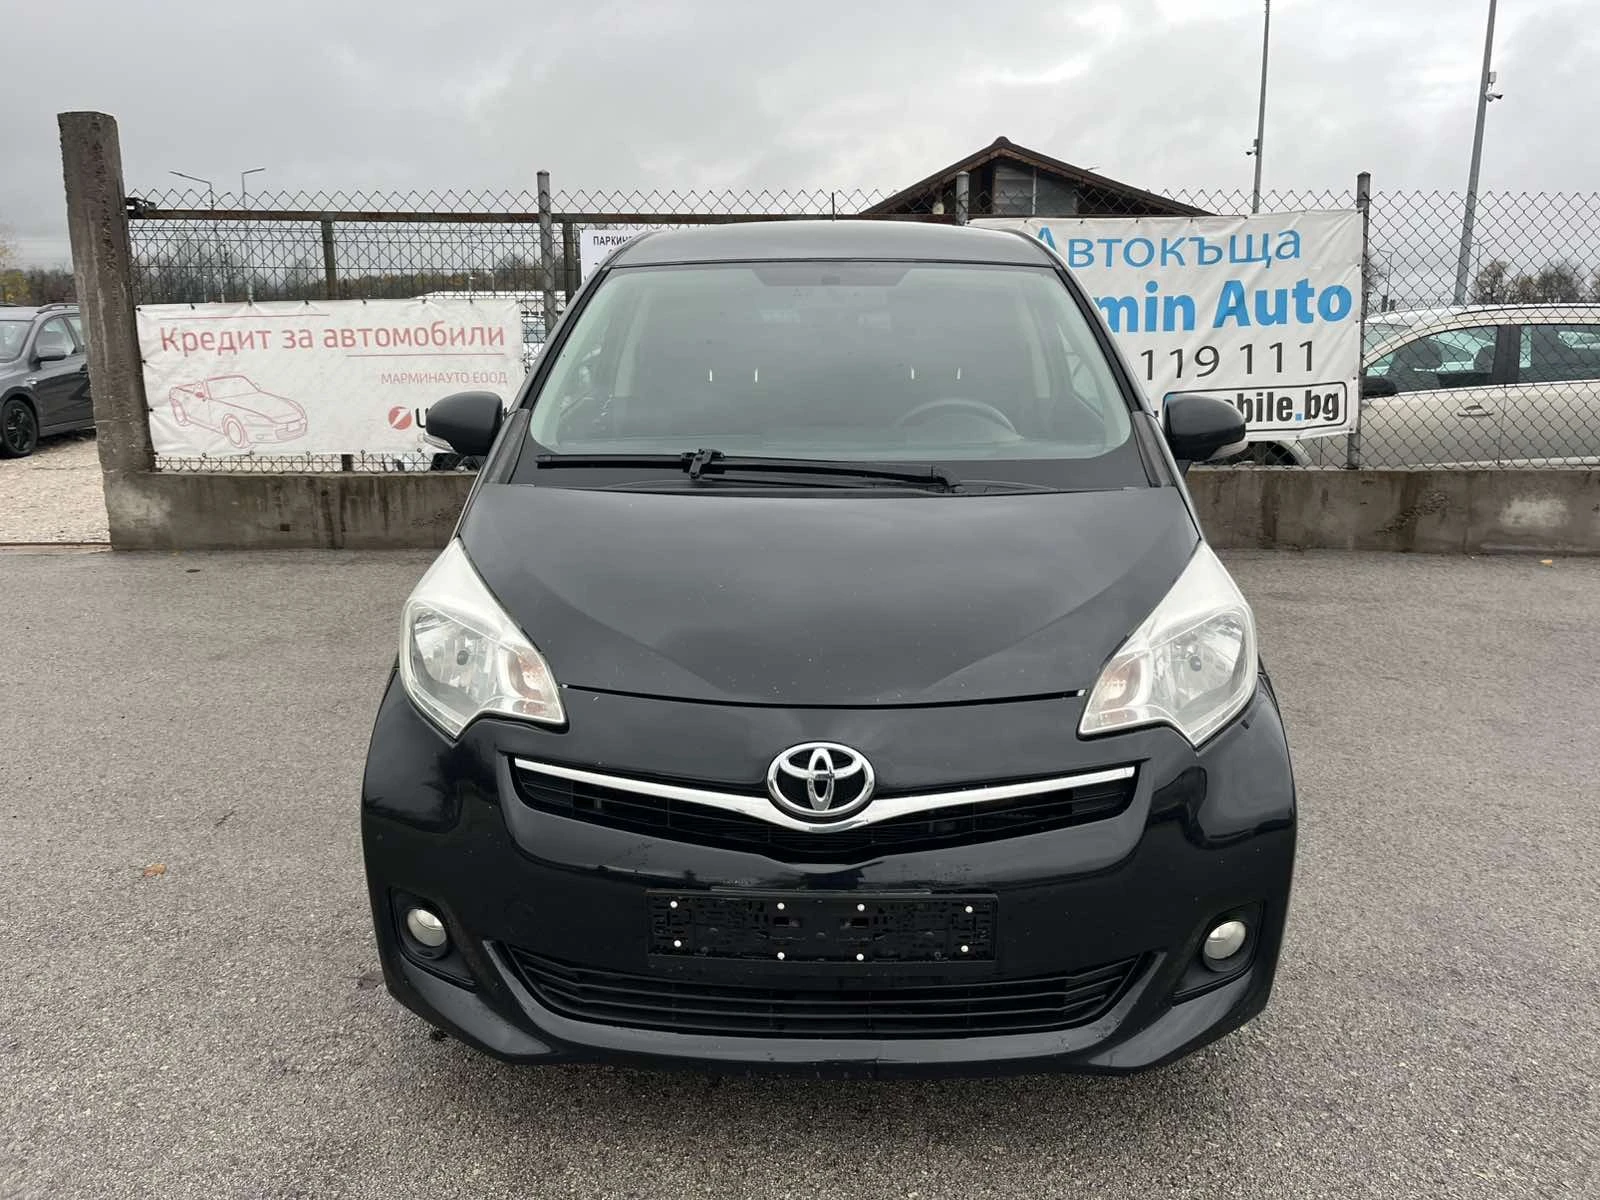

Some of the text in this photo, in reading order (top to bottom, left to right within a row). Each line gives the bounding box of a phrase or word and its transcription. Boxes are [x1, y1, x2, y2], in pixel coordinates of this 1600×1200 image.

[592, 235, 633, 246] ПАРКИН
[1037, 227, 1301, 269] Автокъща
[1094, 278, 1353, 333] min Auto
[159, 320, 505, 357] Кредит за автомобили
[380, 371, 508, 385] МАРМИНАУТО ЕООД
[1140, 341, 1313, 381] 119 111
[1230, 389, 1340, 425] bile.bg
